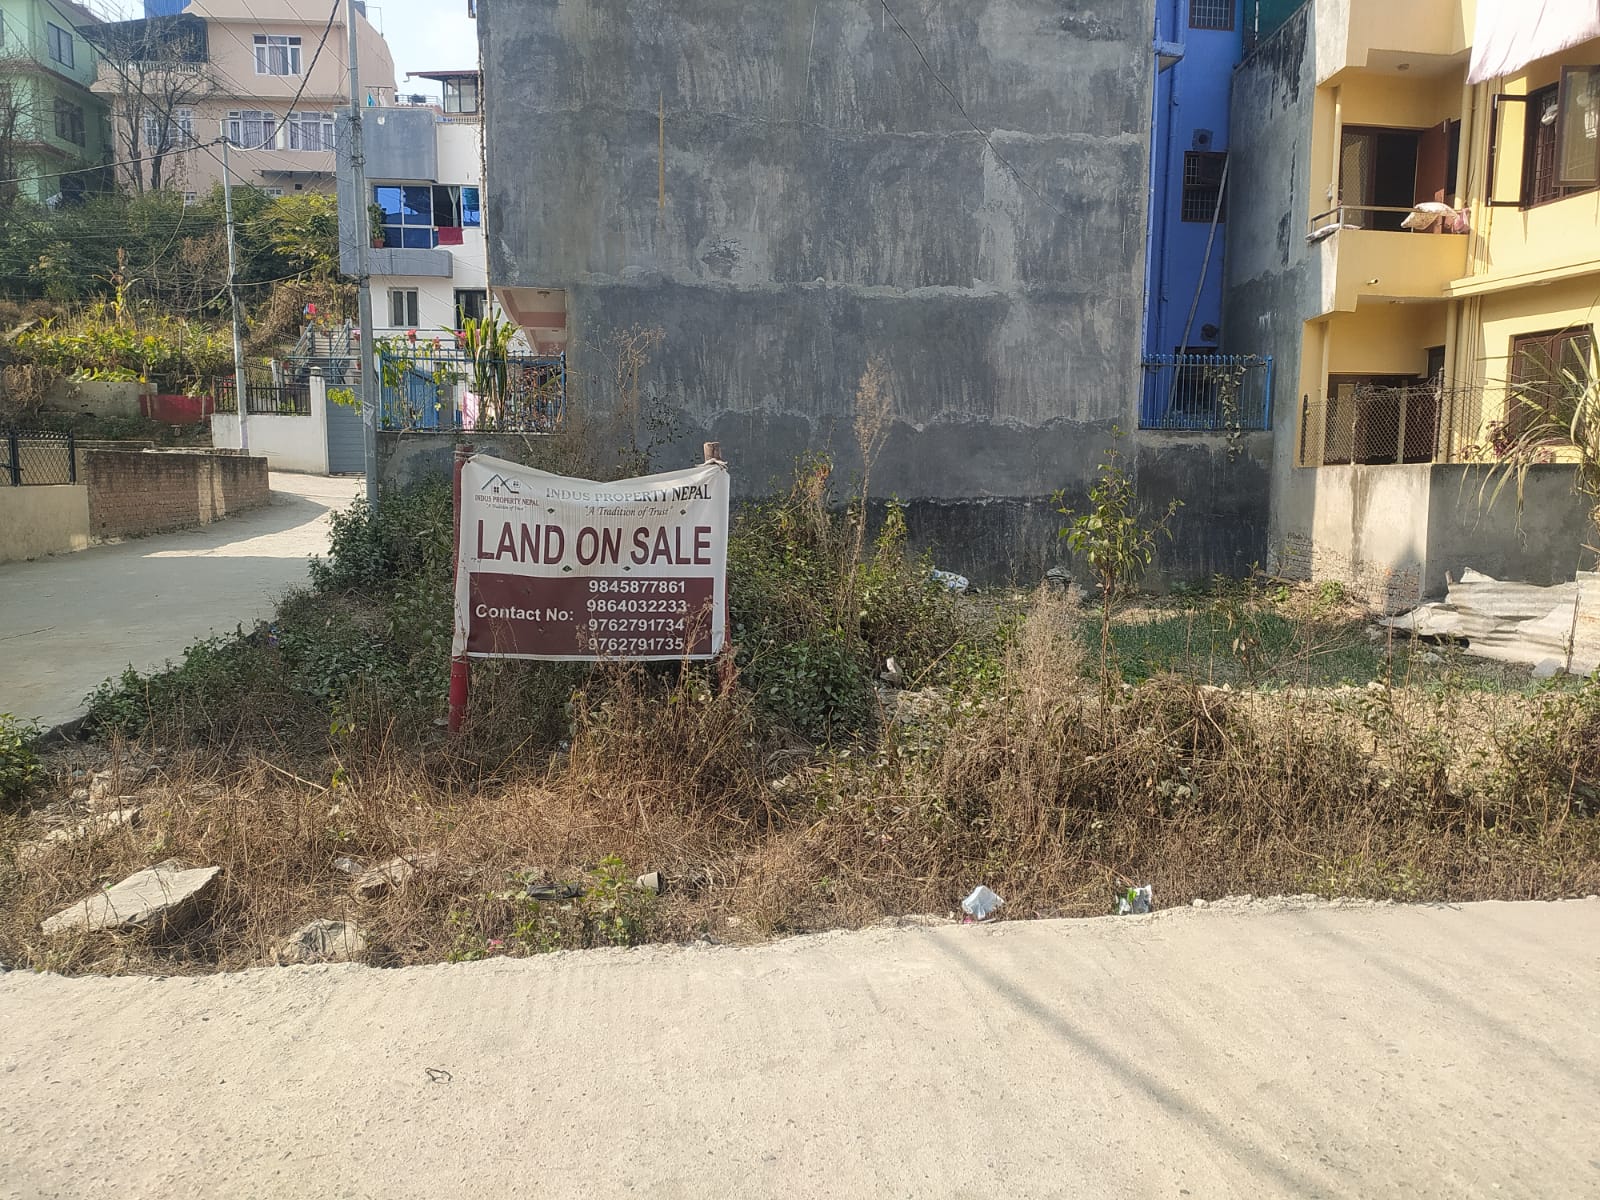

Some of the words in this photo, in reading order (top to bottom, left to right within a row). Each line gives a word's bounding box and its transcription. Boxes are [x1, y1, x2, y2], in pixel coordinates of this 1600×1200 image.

[546, 487, 589, 501] INDUS
[595, 490, 667, 502] PROPERTY
[672, 484, 712, 502] NEPAL
[475, 494, 491, 502] INDUS
[492, 496, 520, 505] PROPERTY
[521, 499, 539, 507] NEPAL
[598, 506, 634, 517] Tradition
[637, 506, 647, 519] of
[478, 520, 564, 564] LAND
[576, 527, 622, 565] ON
[630, 526, 712, 565] SALE
[588, 580, 686, 594] 9845877861
[475, 604, 541, 622] Contact
[546, 608, 574, 621] No:
[586, 599, 687, 613] 9864032233
[588, 618, 685, 632] 9762791734
[588, 637, 684, 651] 9762791735
